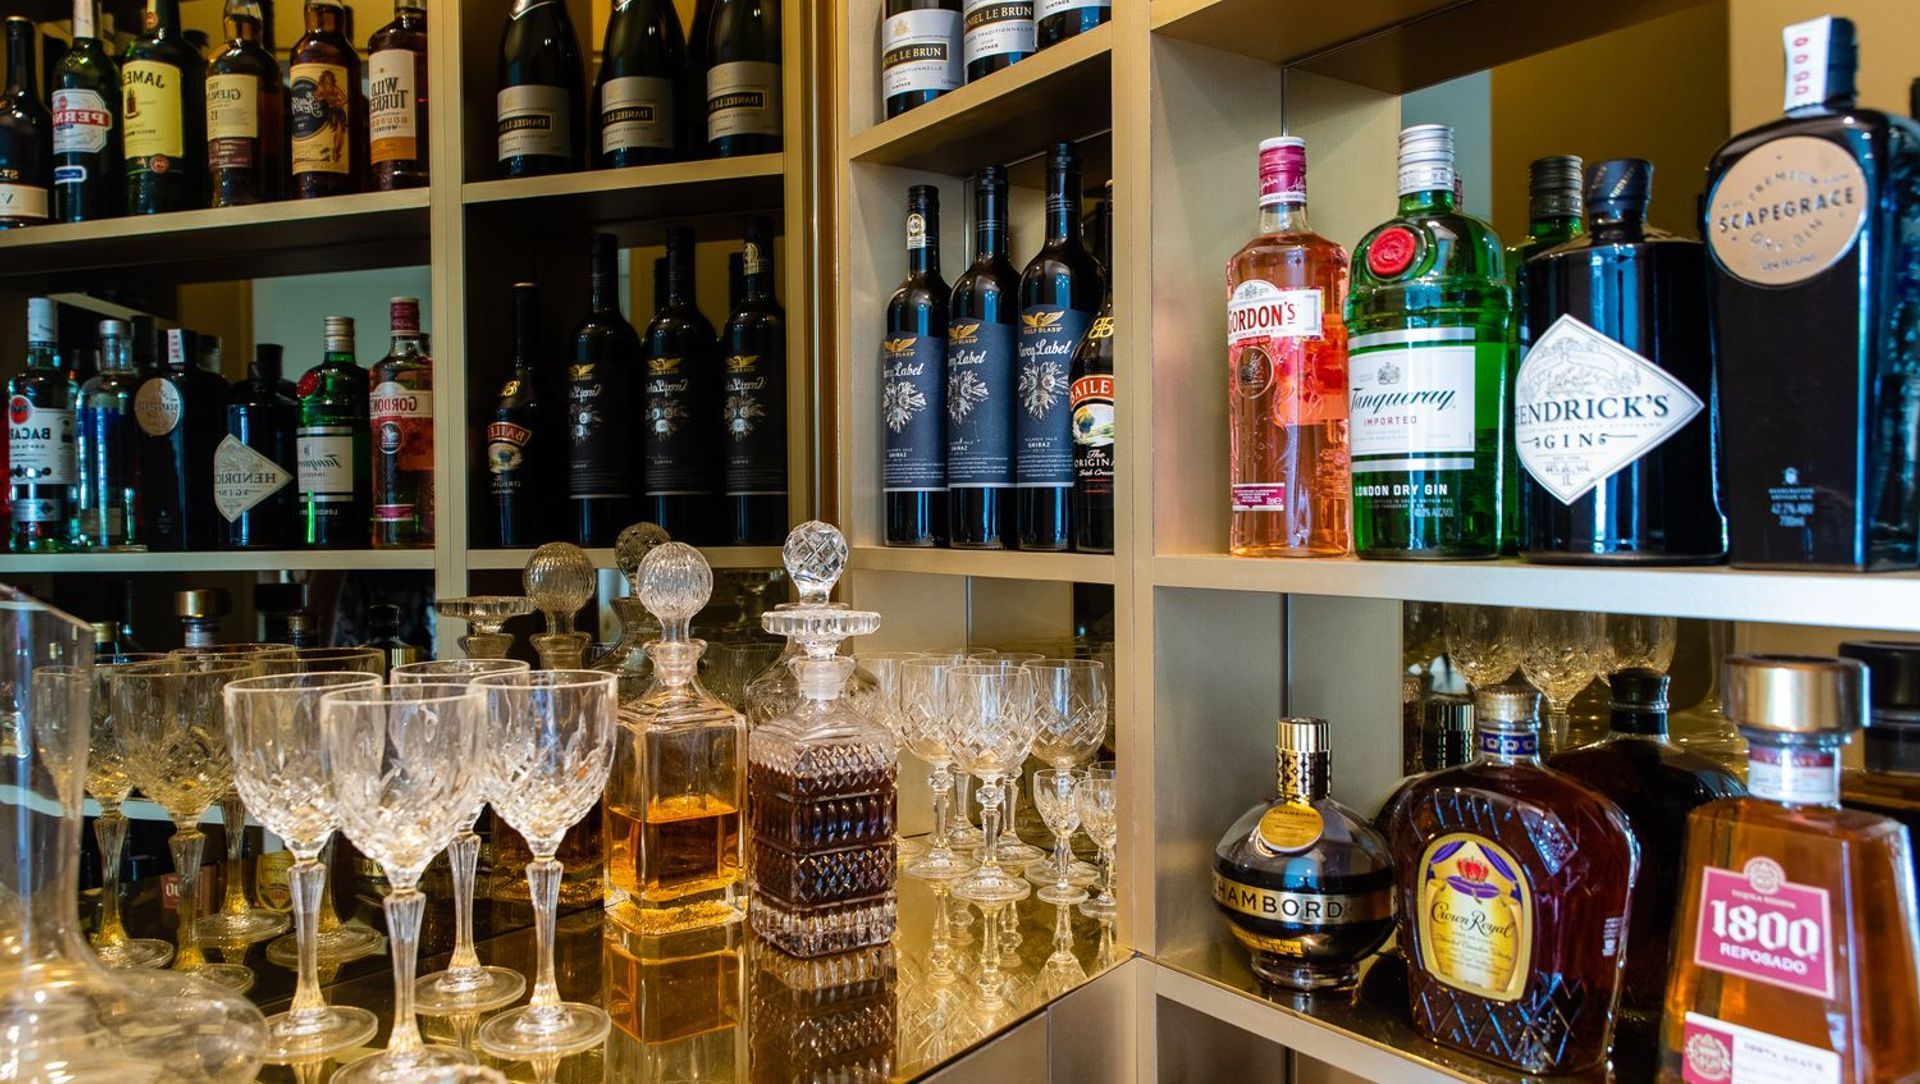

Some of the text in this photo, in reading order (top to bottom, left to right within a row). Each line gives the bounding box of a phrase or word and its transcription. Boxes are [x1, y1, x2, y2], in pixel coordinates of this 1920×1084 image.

[986, 8, 999, 20] LE
[1001, 6, 1032, 18] BRUN
[913, 47, 941, 57] BRUN
[1719, 187, 1853, 233] SCAPEGRACE
[1035, 338, 1072, 355] Label
[956, 350, 987, 365] Label
[894, 362, 924, 377] Label
[1350, 387, 1456, 415] Tanqueray
[1364, 415, 1417, 428] IMPORTED
[1544, 433, 1593, 449] GIN
[1086, 449, 1106, 459] The
[1355, 484, 1448, 497] LONDON DRY GIN
[1430, 900, 1470, 925] Crown
[1464, 910, 1517, 939] Royal
[1710, 898, 1820, 959] 1800
[1719, 942, 1808, 976] REPOSADO
